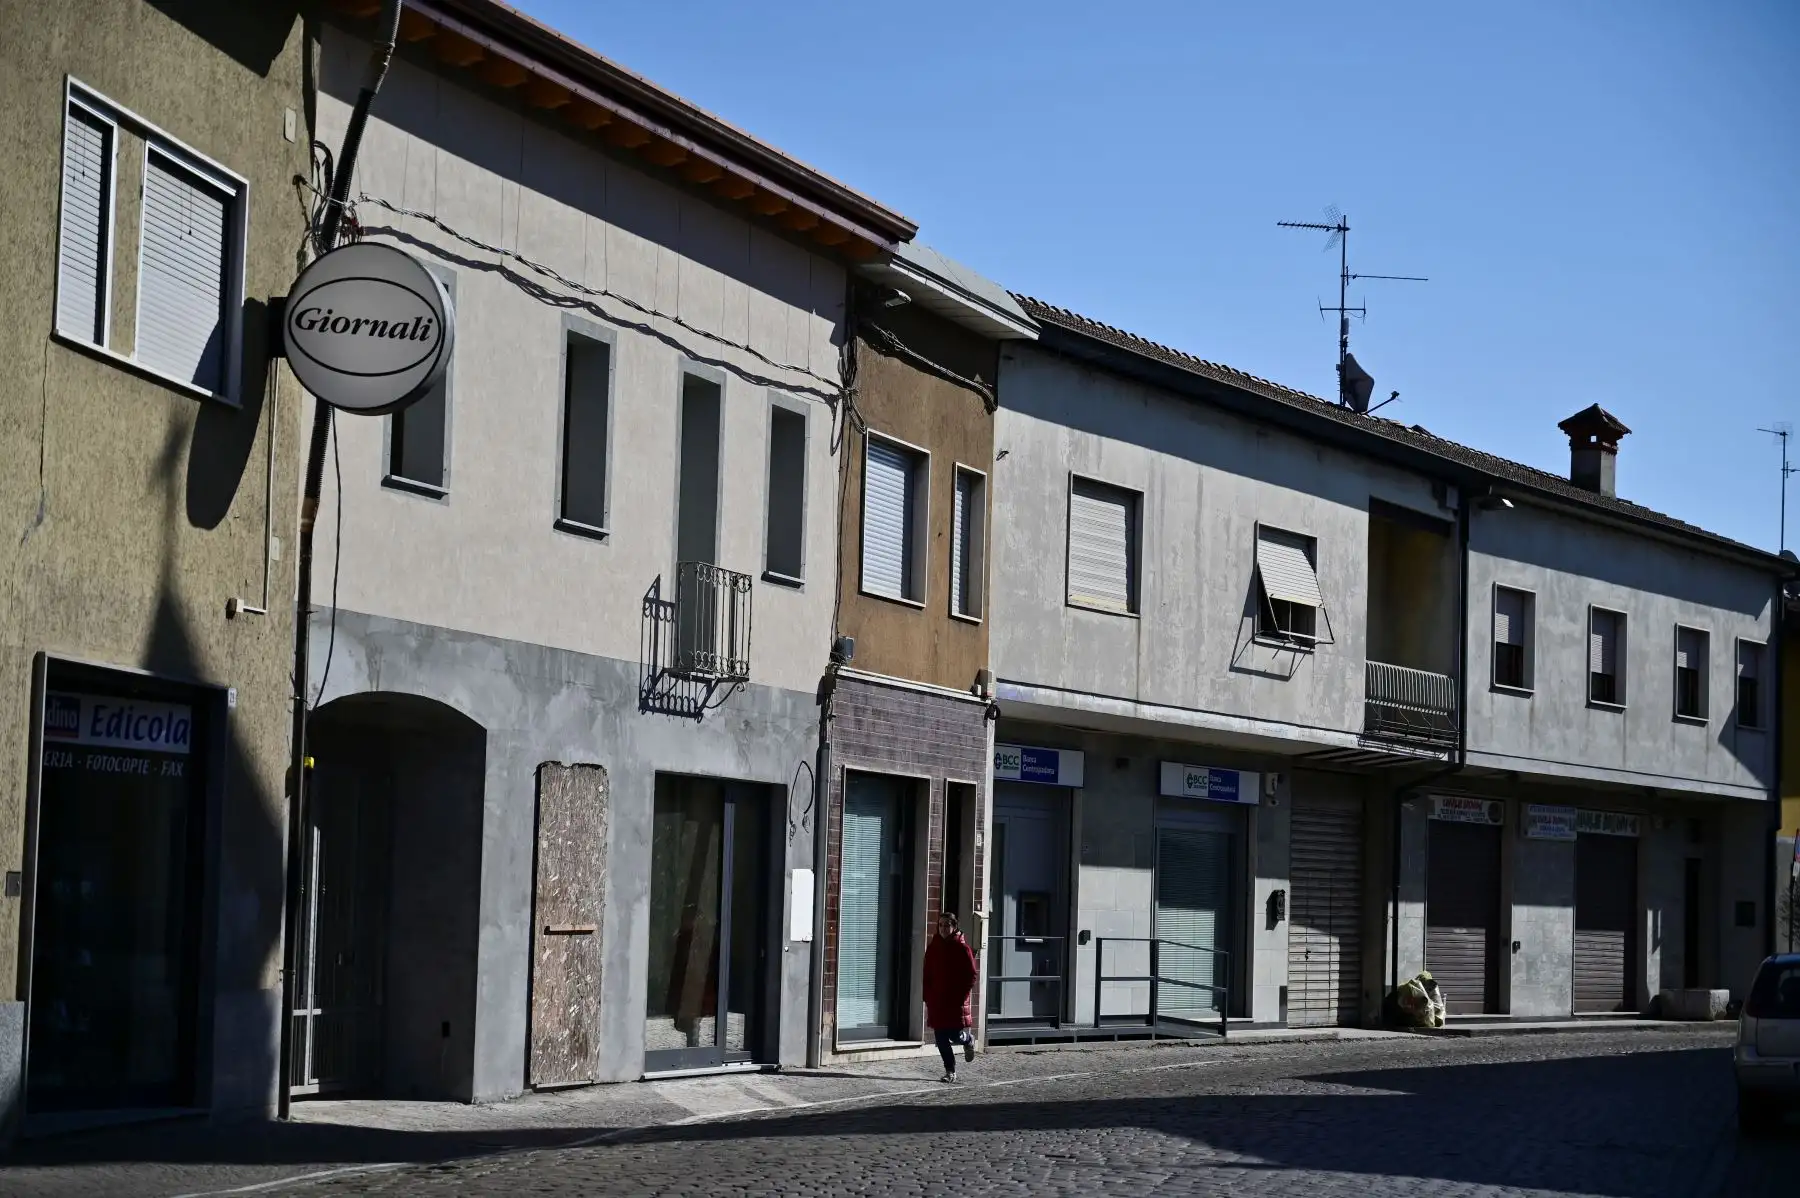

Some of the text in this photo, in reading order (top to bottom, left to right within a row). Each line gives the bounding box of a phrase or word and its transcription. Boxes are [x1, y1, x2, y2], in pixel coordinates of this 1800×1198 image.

[295, 307, 434, 342] Giornali
[91, 704, 189, 745] Edicola
[86, 754, 150, 775] FOTOCOPIE
[160, 760, 185, 777] FAX
[1002, 754, 1020, 766] BCC
[1193, 775, 1207, 785] BCC
